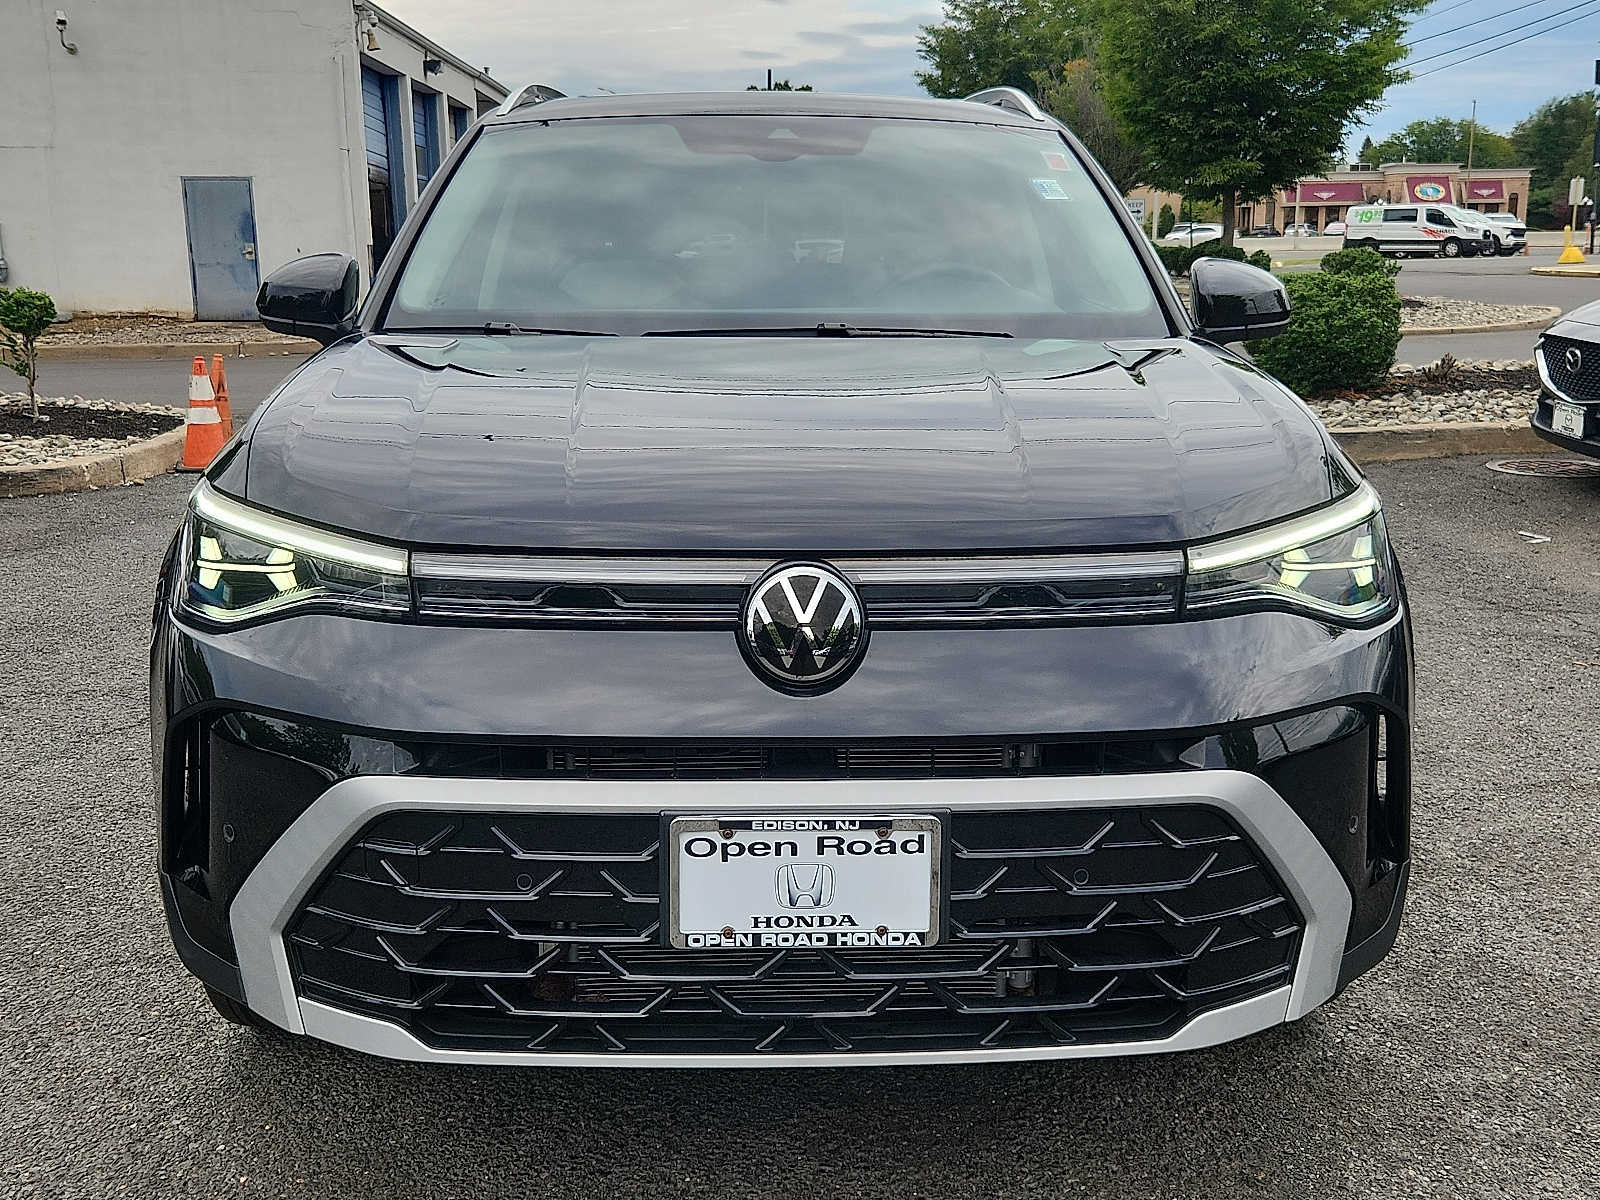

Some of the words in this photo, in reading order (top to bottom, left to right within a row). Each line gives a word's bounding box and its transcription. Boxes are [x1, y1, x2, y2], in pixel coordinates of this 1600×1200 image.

[751, 819, 829, 831] EDISON,
[835, 819, 860, 831] NJ
[683, 836, 799, 863] Open
[816, 833, 926, 857] Road
[750, 914, 859, 930] HONDA
[687, 933, 753, 948] OPEN
[760, 932, 829, 947] ROAD
[836, 932, 922, 947] HONDA
